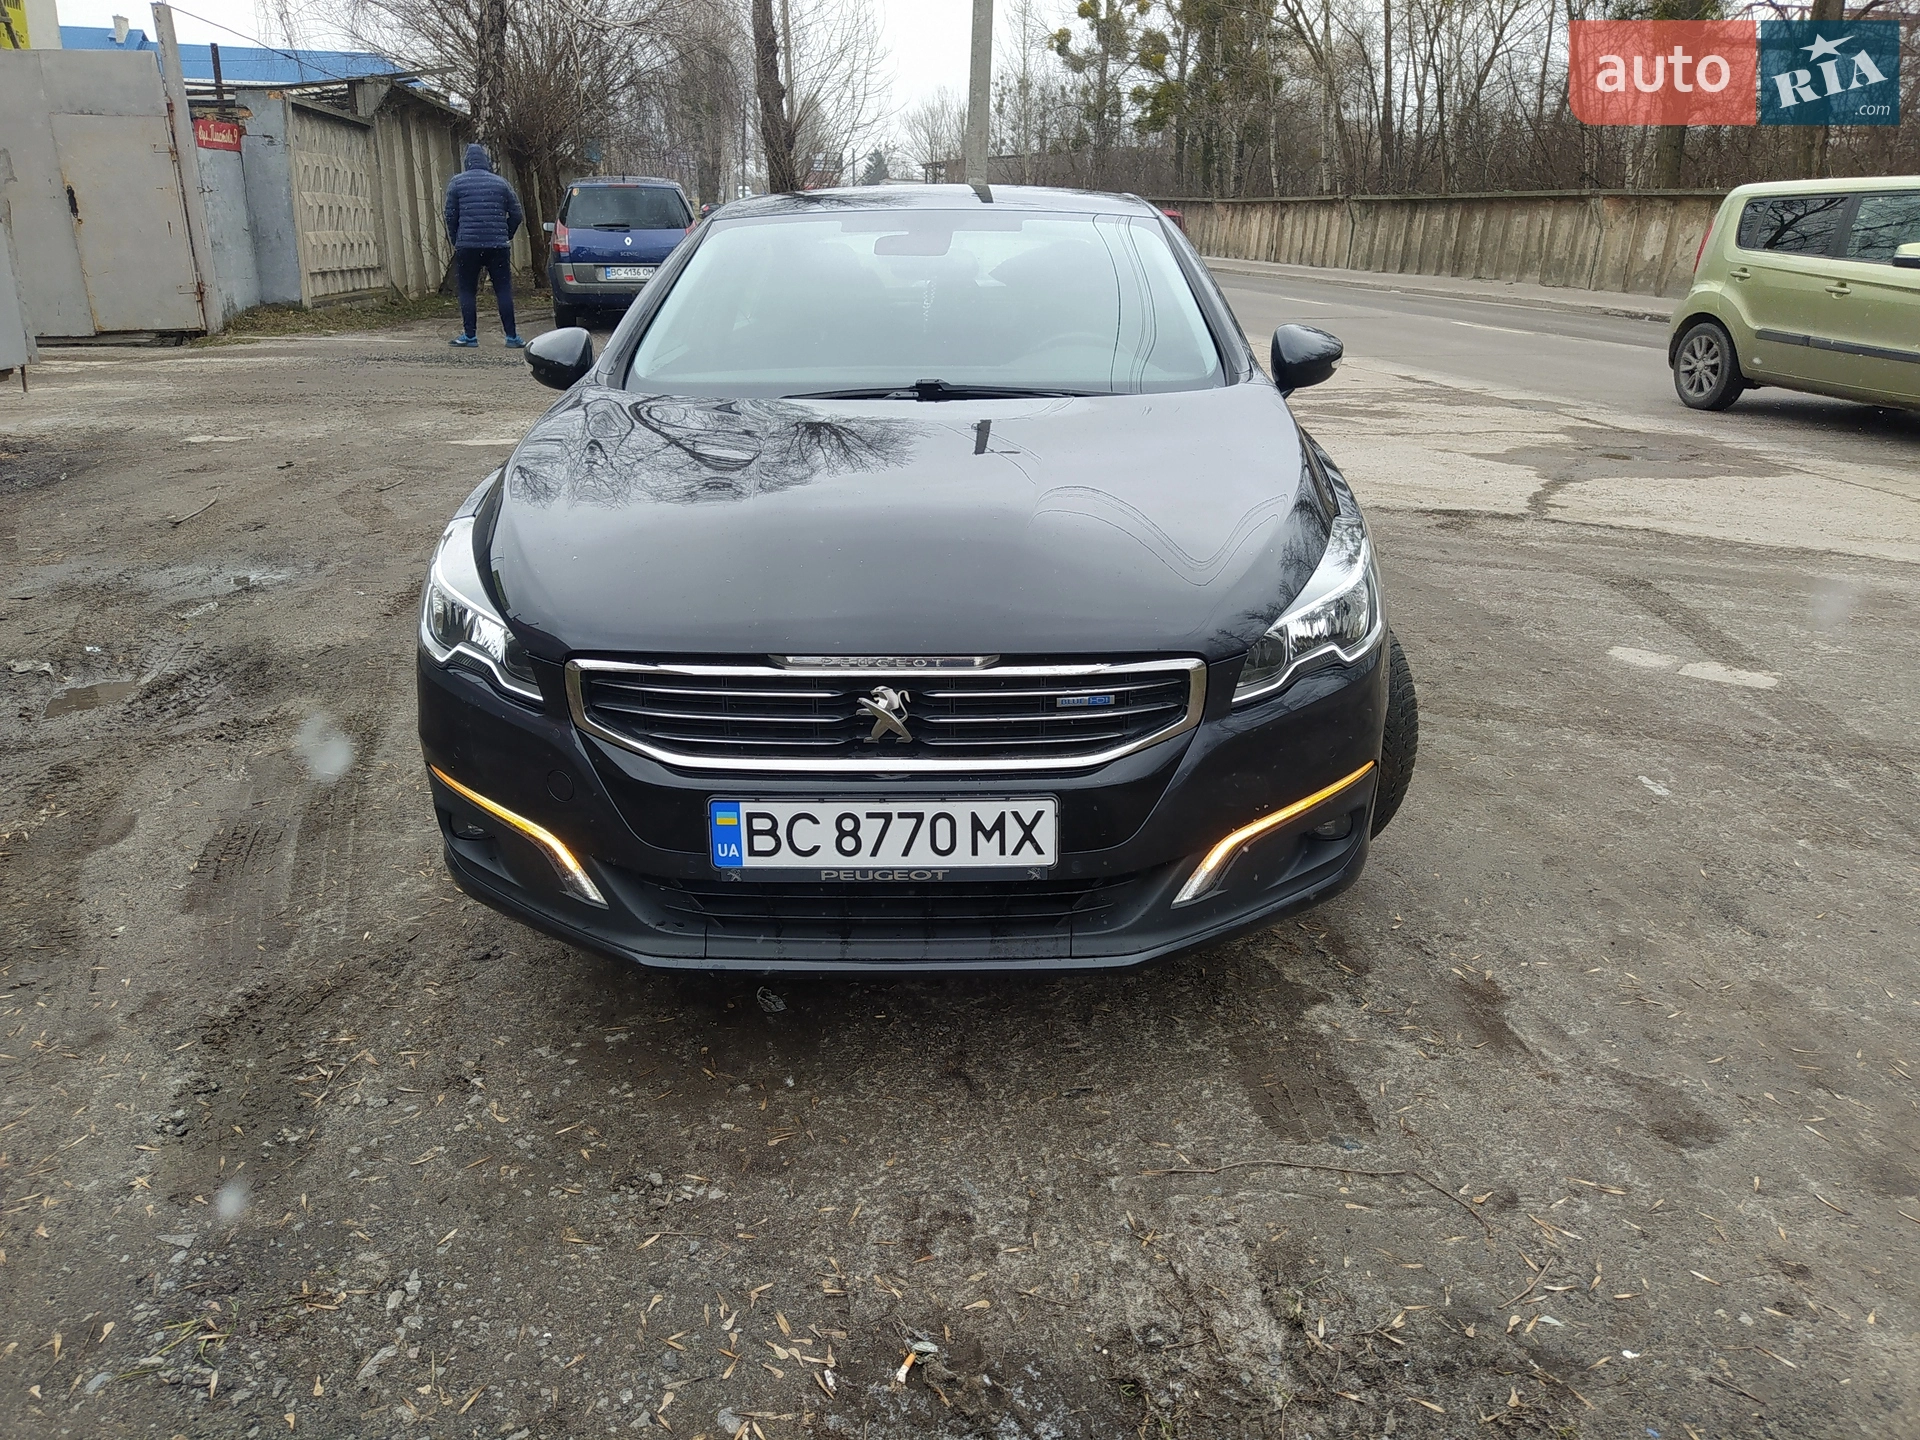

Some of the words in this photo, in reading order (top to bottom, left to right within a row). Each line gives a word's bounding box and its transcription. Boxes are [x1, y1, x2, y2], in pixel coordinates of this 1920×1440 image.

[610, 268, 622, 276] BC
[624, 268, 641, 276] 4136
[821, 657, 945, 667] PEUGEOT
[746, 812, 821, 858] BC
[835, 811, 957, 858] 8770
[970, 810, 1045, 857] MX
[718, 845, 739, 858] UA
[820, 869, 950, 881] PEUGEOT
